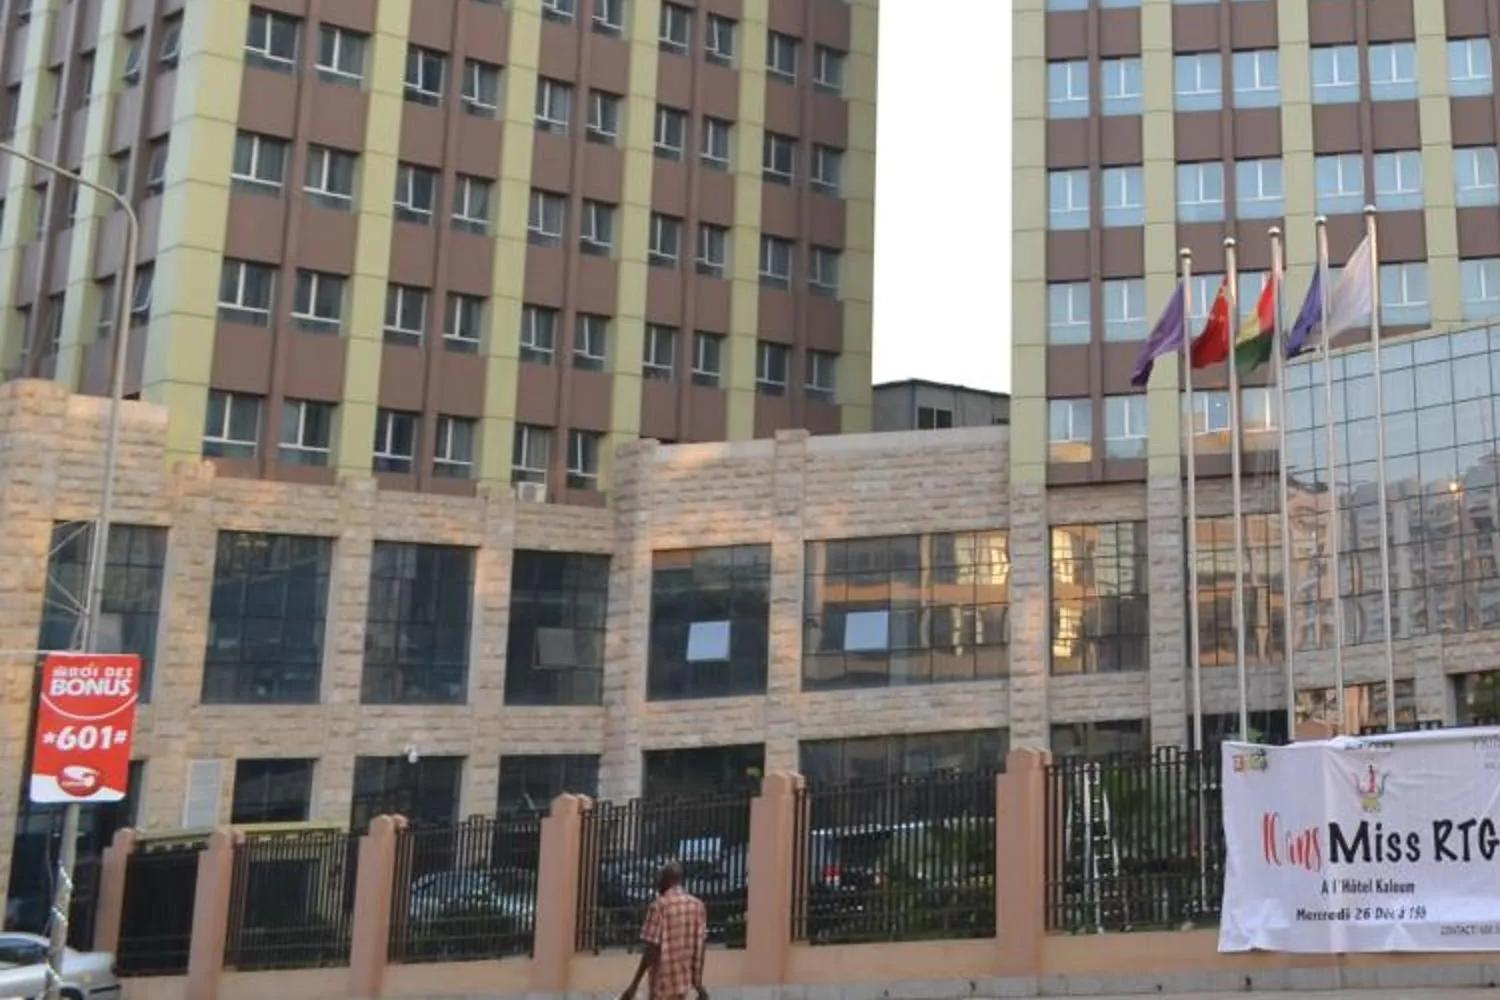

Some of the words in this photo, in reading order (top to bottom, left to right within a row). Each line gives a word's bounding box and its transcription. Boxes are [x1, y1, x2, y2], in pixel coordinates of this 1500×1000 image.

[50, 678, 132, 697] BONUS
[1328, 820, 1421, 864] Miss
[1432, 817, 1500, 862] RTG
[1296, 907, 1350, 920] Mercredi
[1355, 907, 1371, 920] 26
